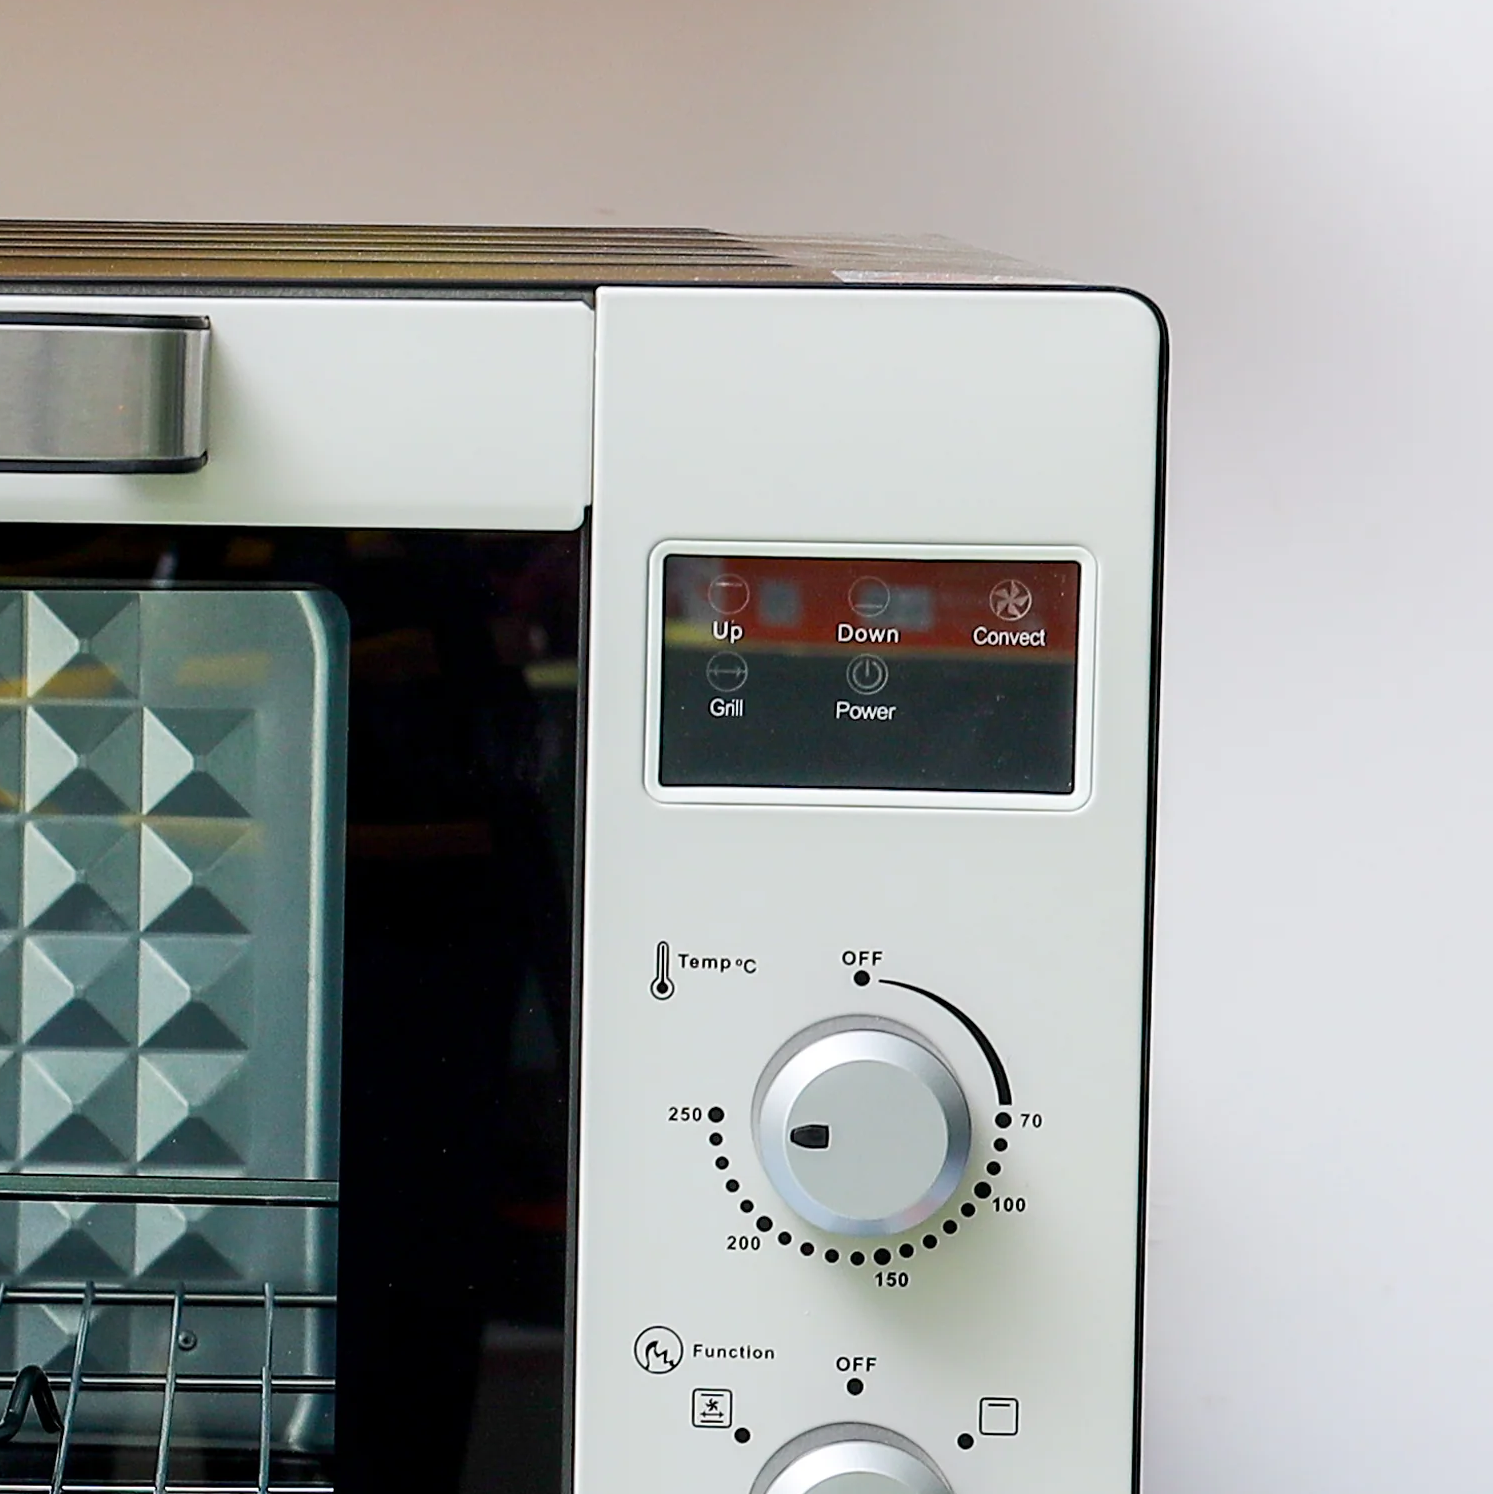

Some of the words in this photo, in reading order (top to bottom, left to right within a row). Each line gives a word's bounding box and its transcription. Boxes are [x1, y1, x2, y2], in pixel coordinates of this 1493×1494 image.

[713, 620, 743, 644] Up
[838, 623, 899, 643] Down
[973, 626, 1046, 647] Convect
[710, 698, 743, 717] Grill
[836, 701, 897, 720] Power
[841, 950, 883, 967] OFF
[668, 1106, 703, 1123] 250
[1020, 1113, 1043, 1129] 70
[992, 1196, 1026, 1213] 100
[726, 1235, 761, 1251] 200
[874, 1271, 909, 1288] 150
[692, 1343, 775, 1360] Function
[835, 1356, 878, 1373] OFF
